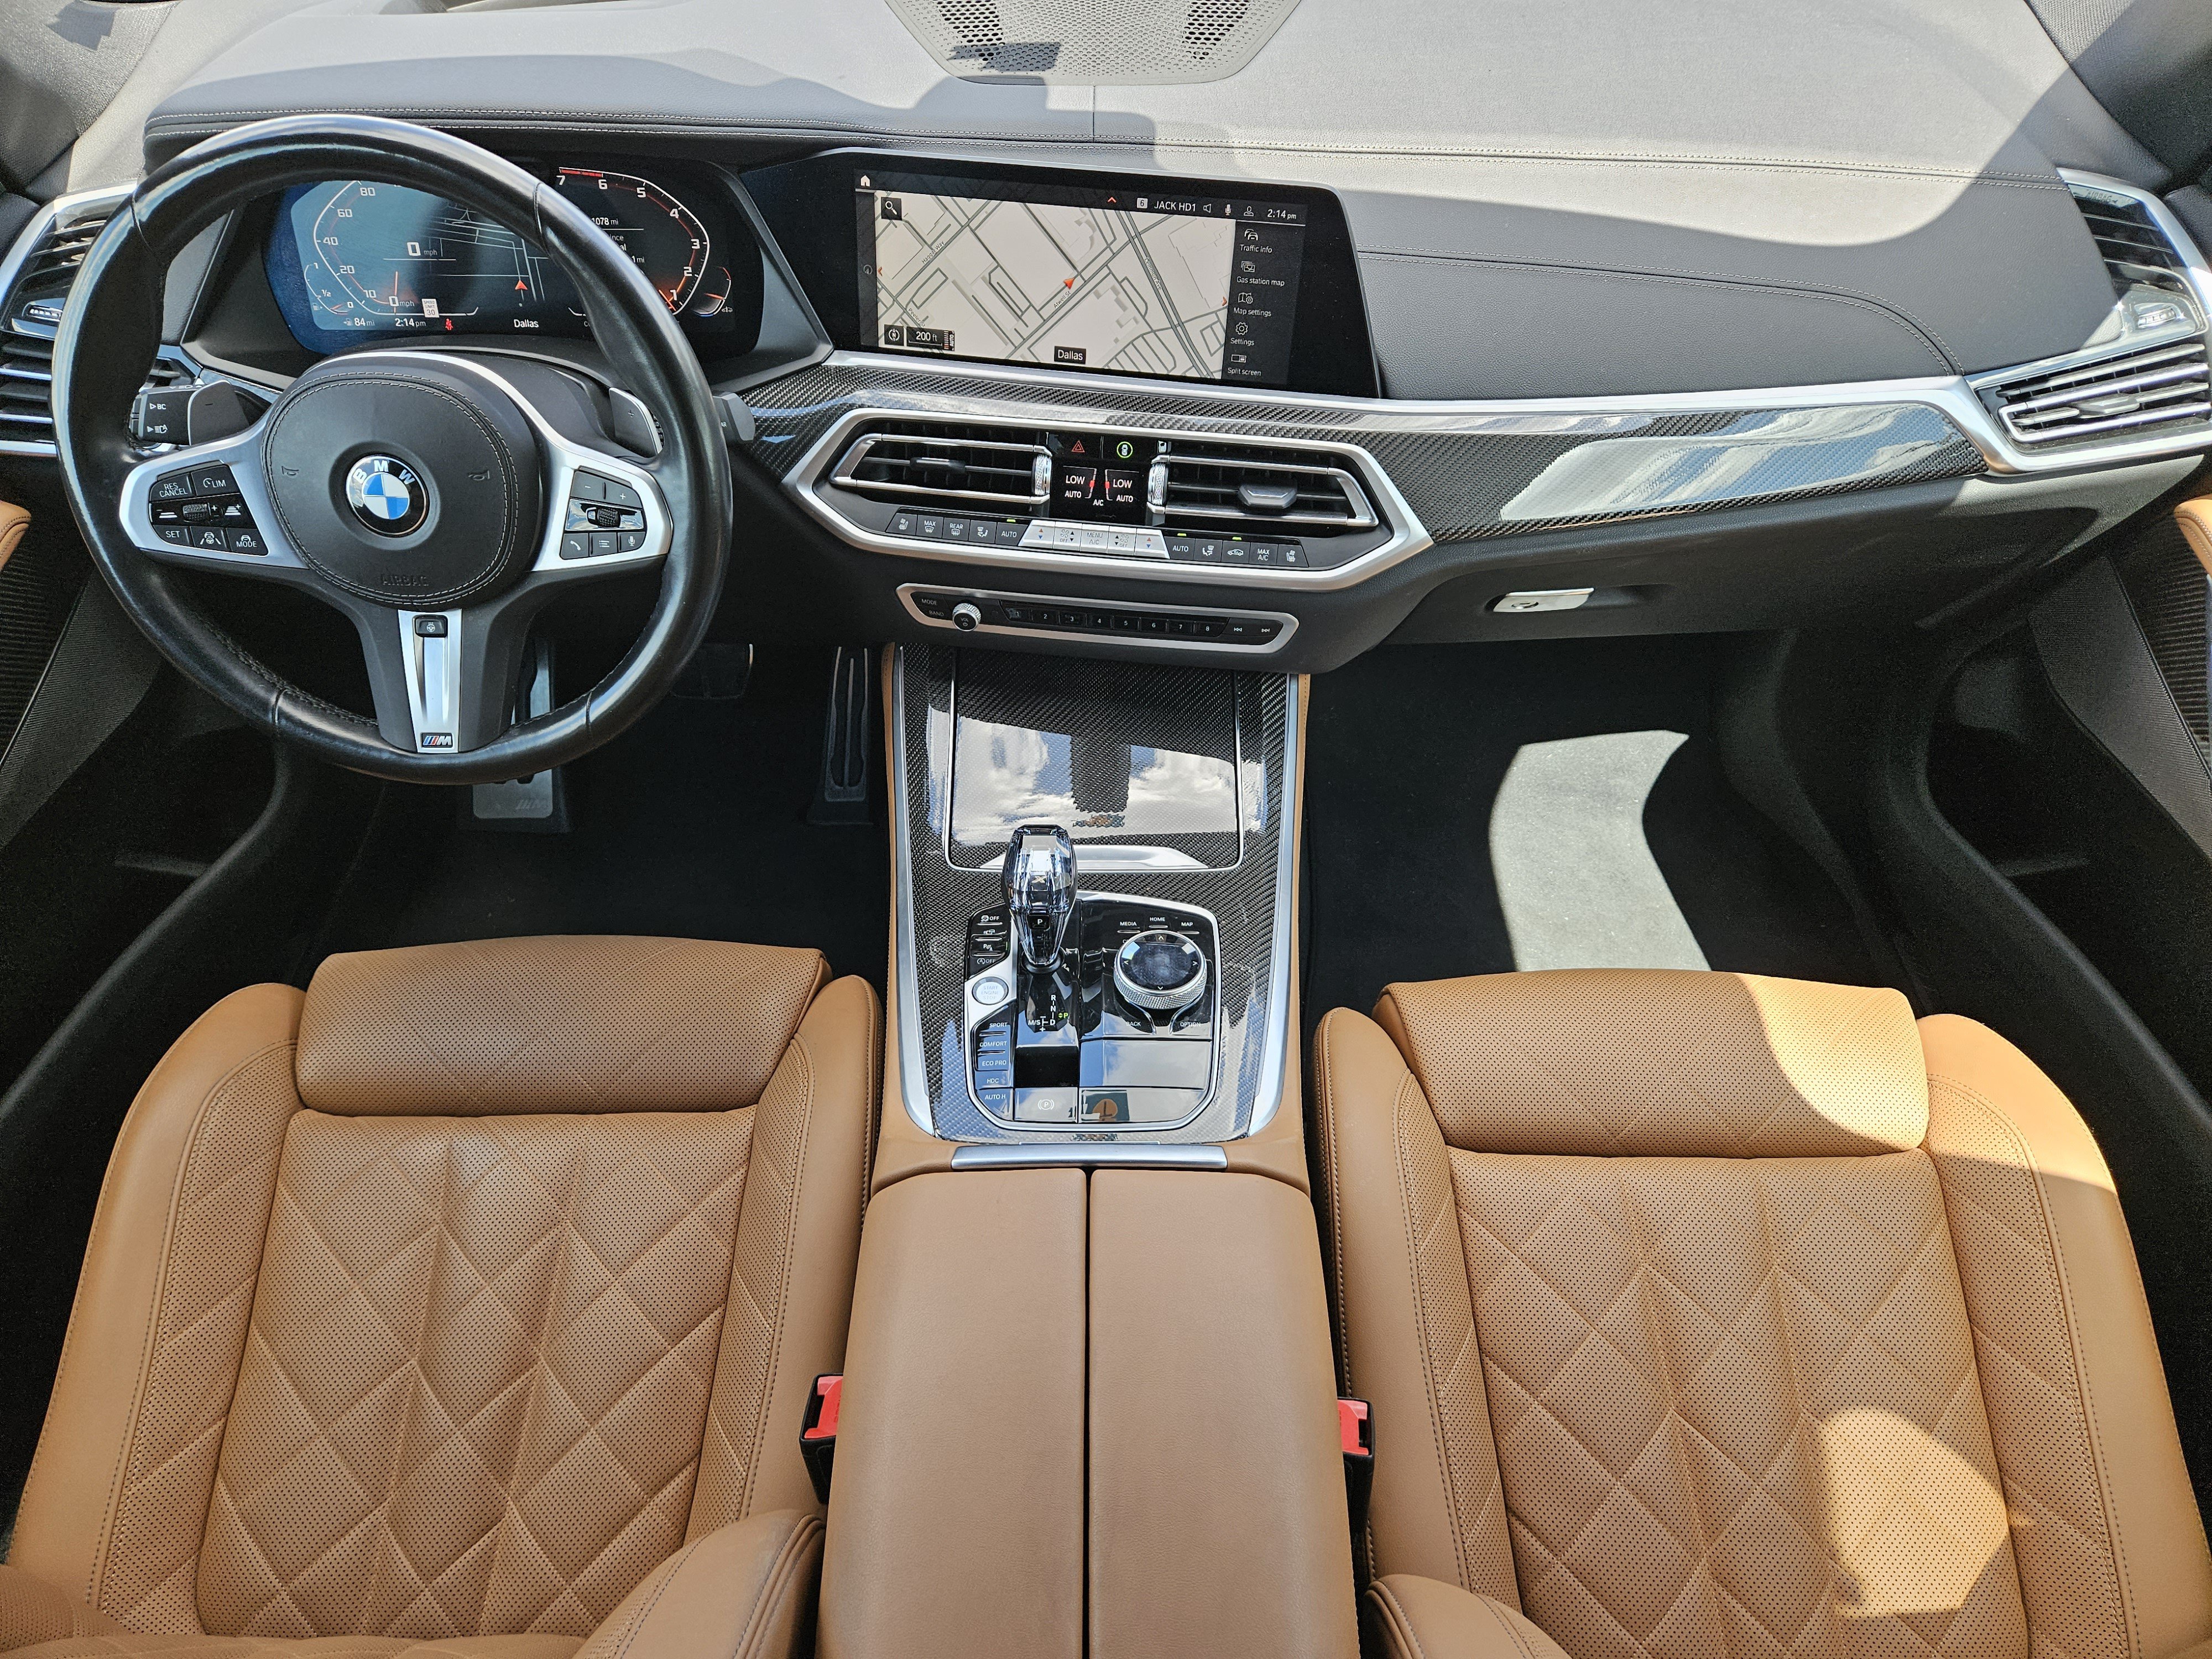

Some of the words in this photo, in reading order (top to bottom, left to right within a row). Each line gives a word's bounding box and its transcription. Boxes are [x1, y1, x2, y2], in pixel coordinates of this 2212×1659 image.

[556, 175, 566, 185] 7
[598, 180, 607, 190] 6
[359, 187, 376, 196] 80
[637, 187, 646, 199] 5
[1154, 200, 1177, 210] JACK
[1178, 202, 1196, 212] HD1
[337, 209, 353, 217] 60
[670, 208, 679, 219] 4
[1267, 208, 1286, 218] 2:14
[323, 237, 339, 246] 40
[691, 238, 700, 249] 3
[934, 241, 945, 250] Way
[407, 242, 421, 256] 0
[424, 249, 437, 257] mph
[1240, 244, 1259, 252] Traffic
[340, 265, 355, 274] 20
[684, 267, 692, 276] 2
[363, 290, 377, 298] 10
[670, 289, 678, 300] 1
[389, 296, 399, 306] 0
[399, 300, 415, 308] mph
[1053, 295, 1066, 309] Atwell
[909, 307, 921, 322] Peeler
[1233, 307, 1247, 315] Map
[1248, 309, 1271, 317] settings
[354, 317, 366, 327] 84
[394, 317, 415, 327] 2:14
[514, 319, 539, 328] Dallas
[916, 331, 931, 341] 200
[1230, 337, 1255, 346] Settings
[1057, 349, 1083, 361] Dallas
[352, 460, 415, 486] BMW
[1065, 475, 1085, 484] LOW
[1113, 479, 1133, 488] LOW
[164, 482, 179, 491] RES
[159, 488, 188, 498] CANCEL
[1065, 490, 1082, 498] AUTO
[1116, 494, 1134, 503] AUTO
